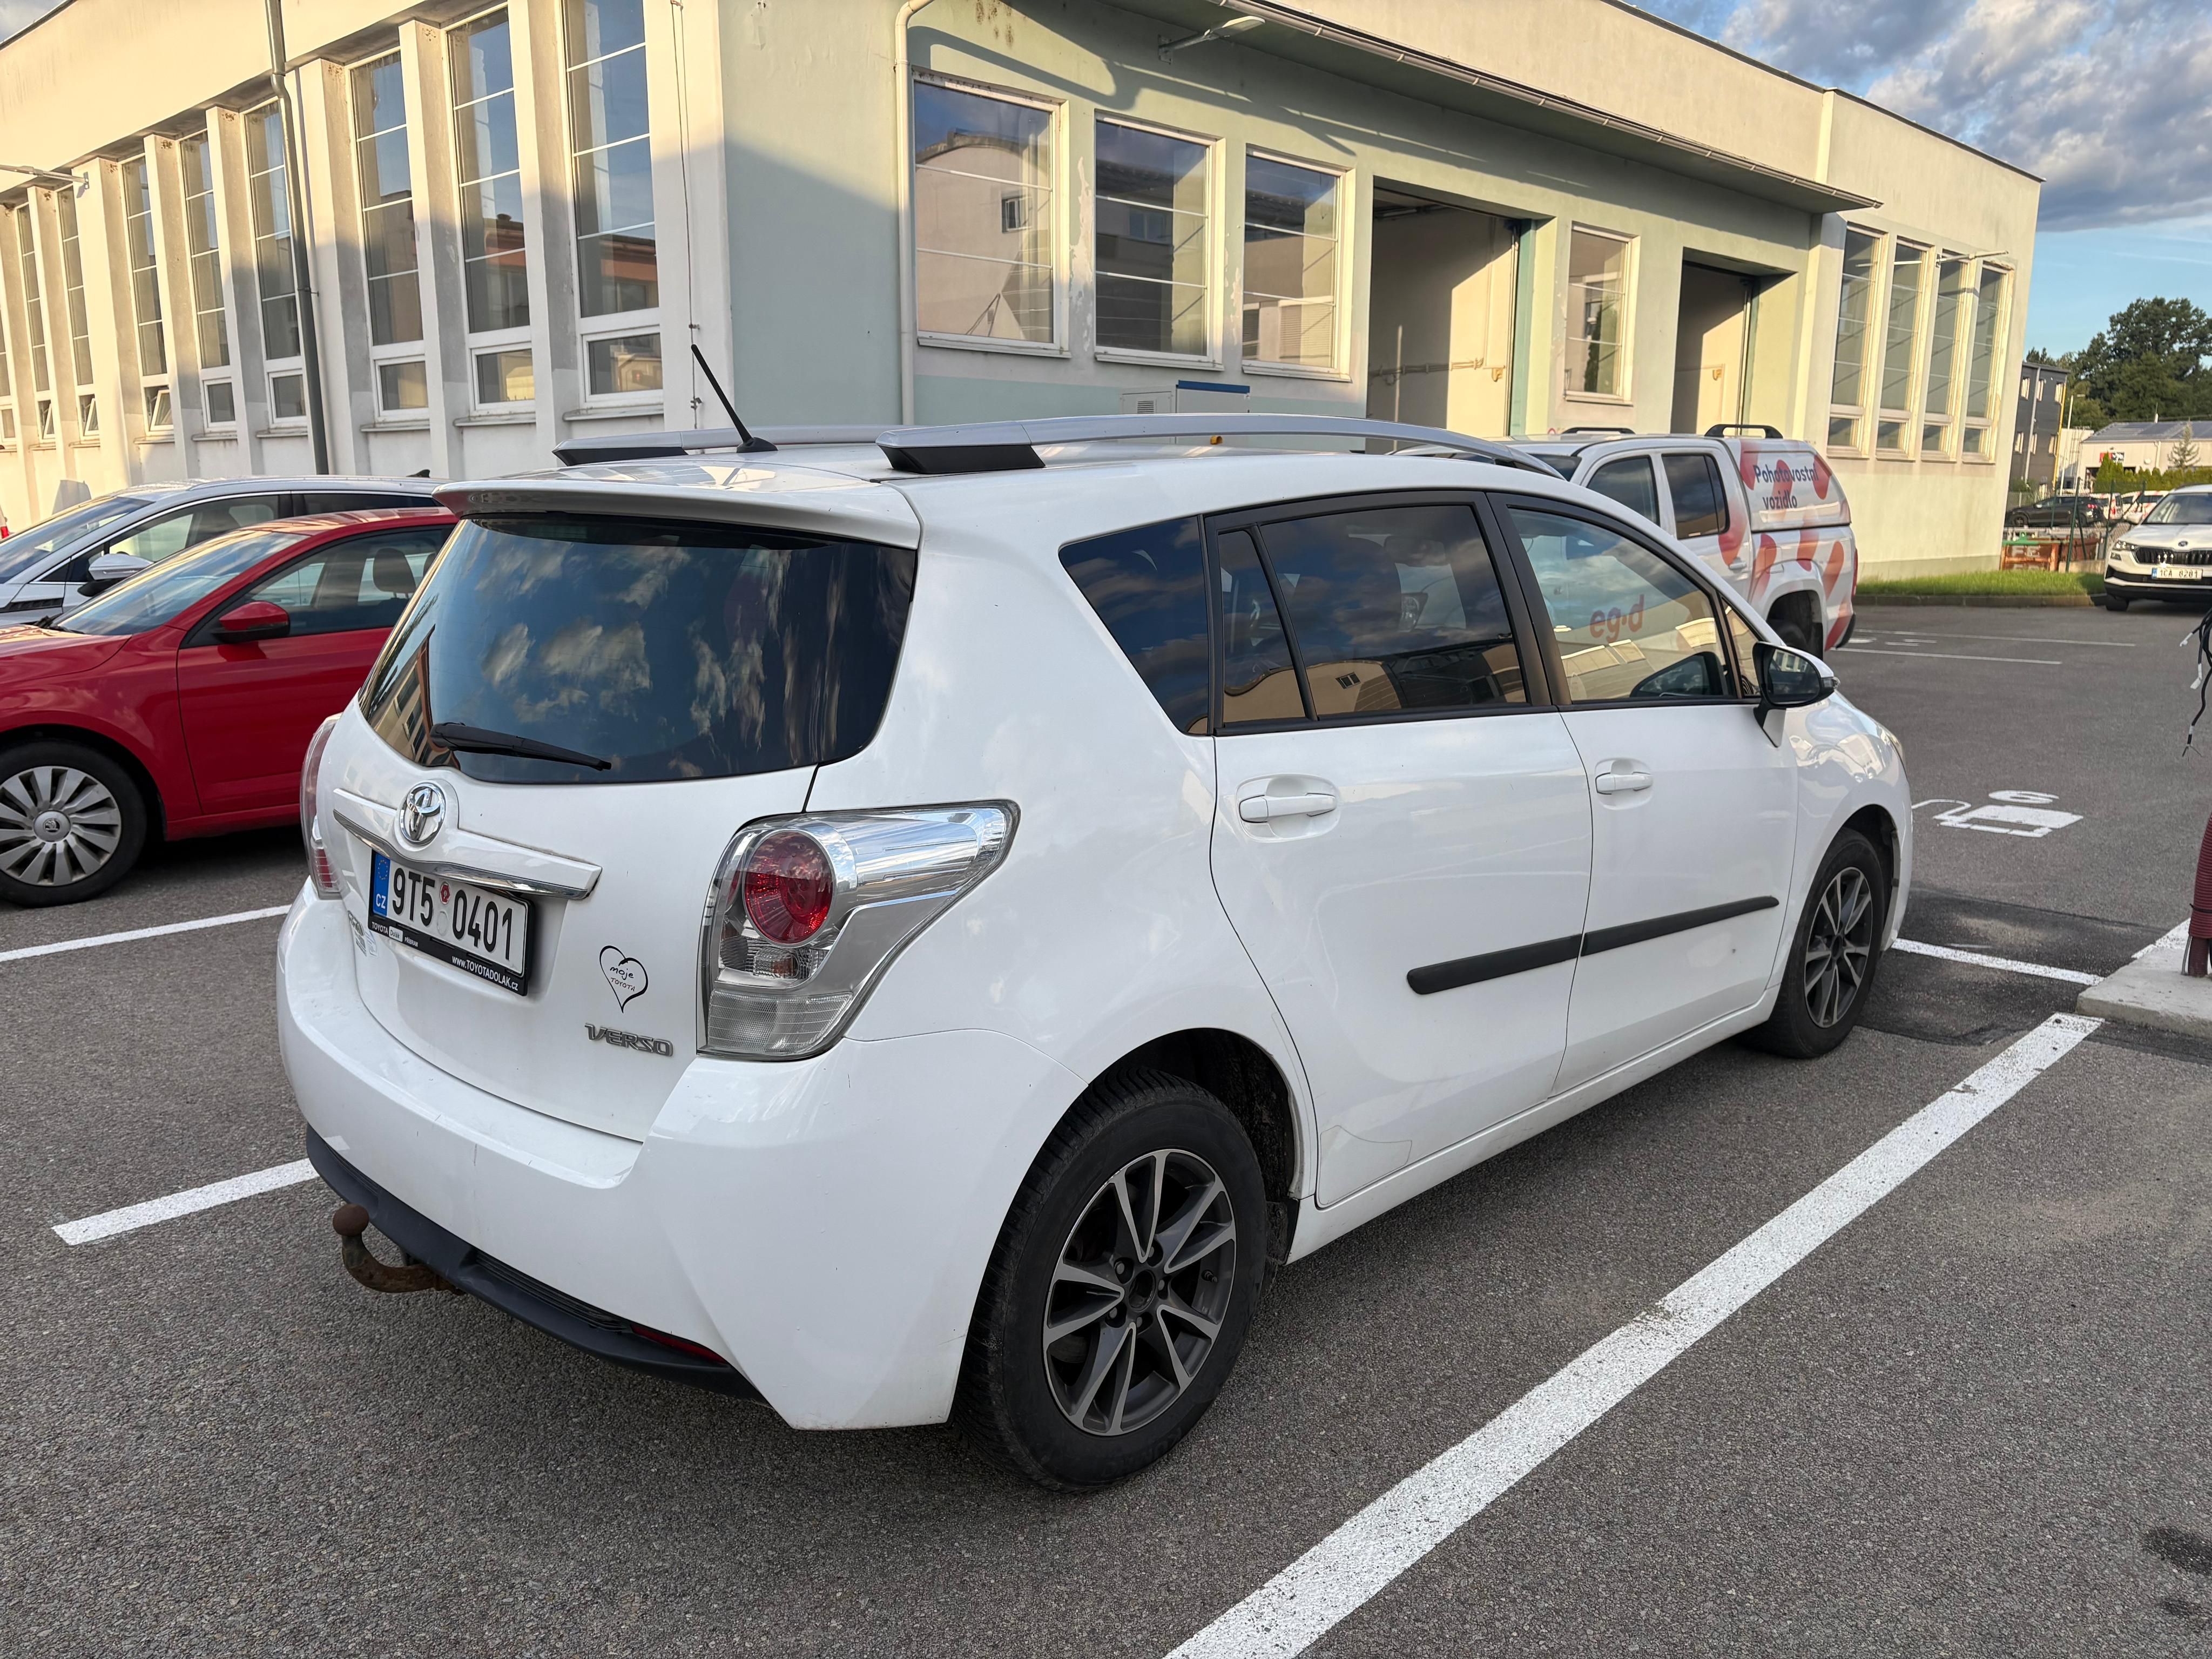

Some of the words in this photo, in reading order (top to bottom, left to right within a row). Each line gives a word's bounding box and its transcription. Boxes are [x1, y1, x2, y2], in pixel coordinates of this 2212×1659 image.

[1753, 463, 1819, 483] Pohotovostní
[1763, 490, 1797, 509] vozidlo
[376, 893, 386, 909] CZ
[392, 867, 435, 926] 9T5
[453, 889, 512, 960] 0401
[372, 922, 388, 934] TOYOTA
[452, 955, 518, 991] www.TOYOTADOLAK.cz
[610, 966, 634, 980] moje
[611, 977, 636, 992] TOYOTA
[584, 1023, 674, 1057] VERSO
